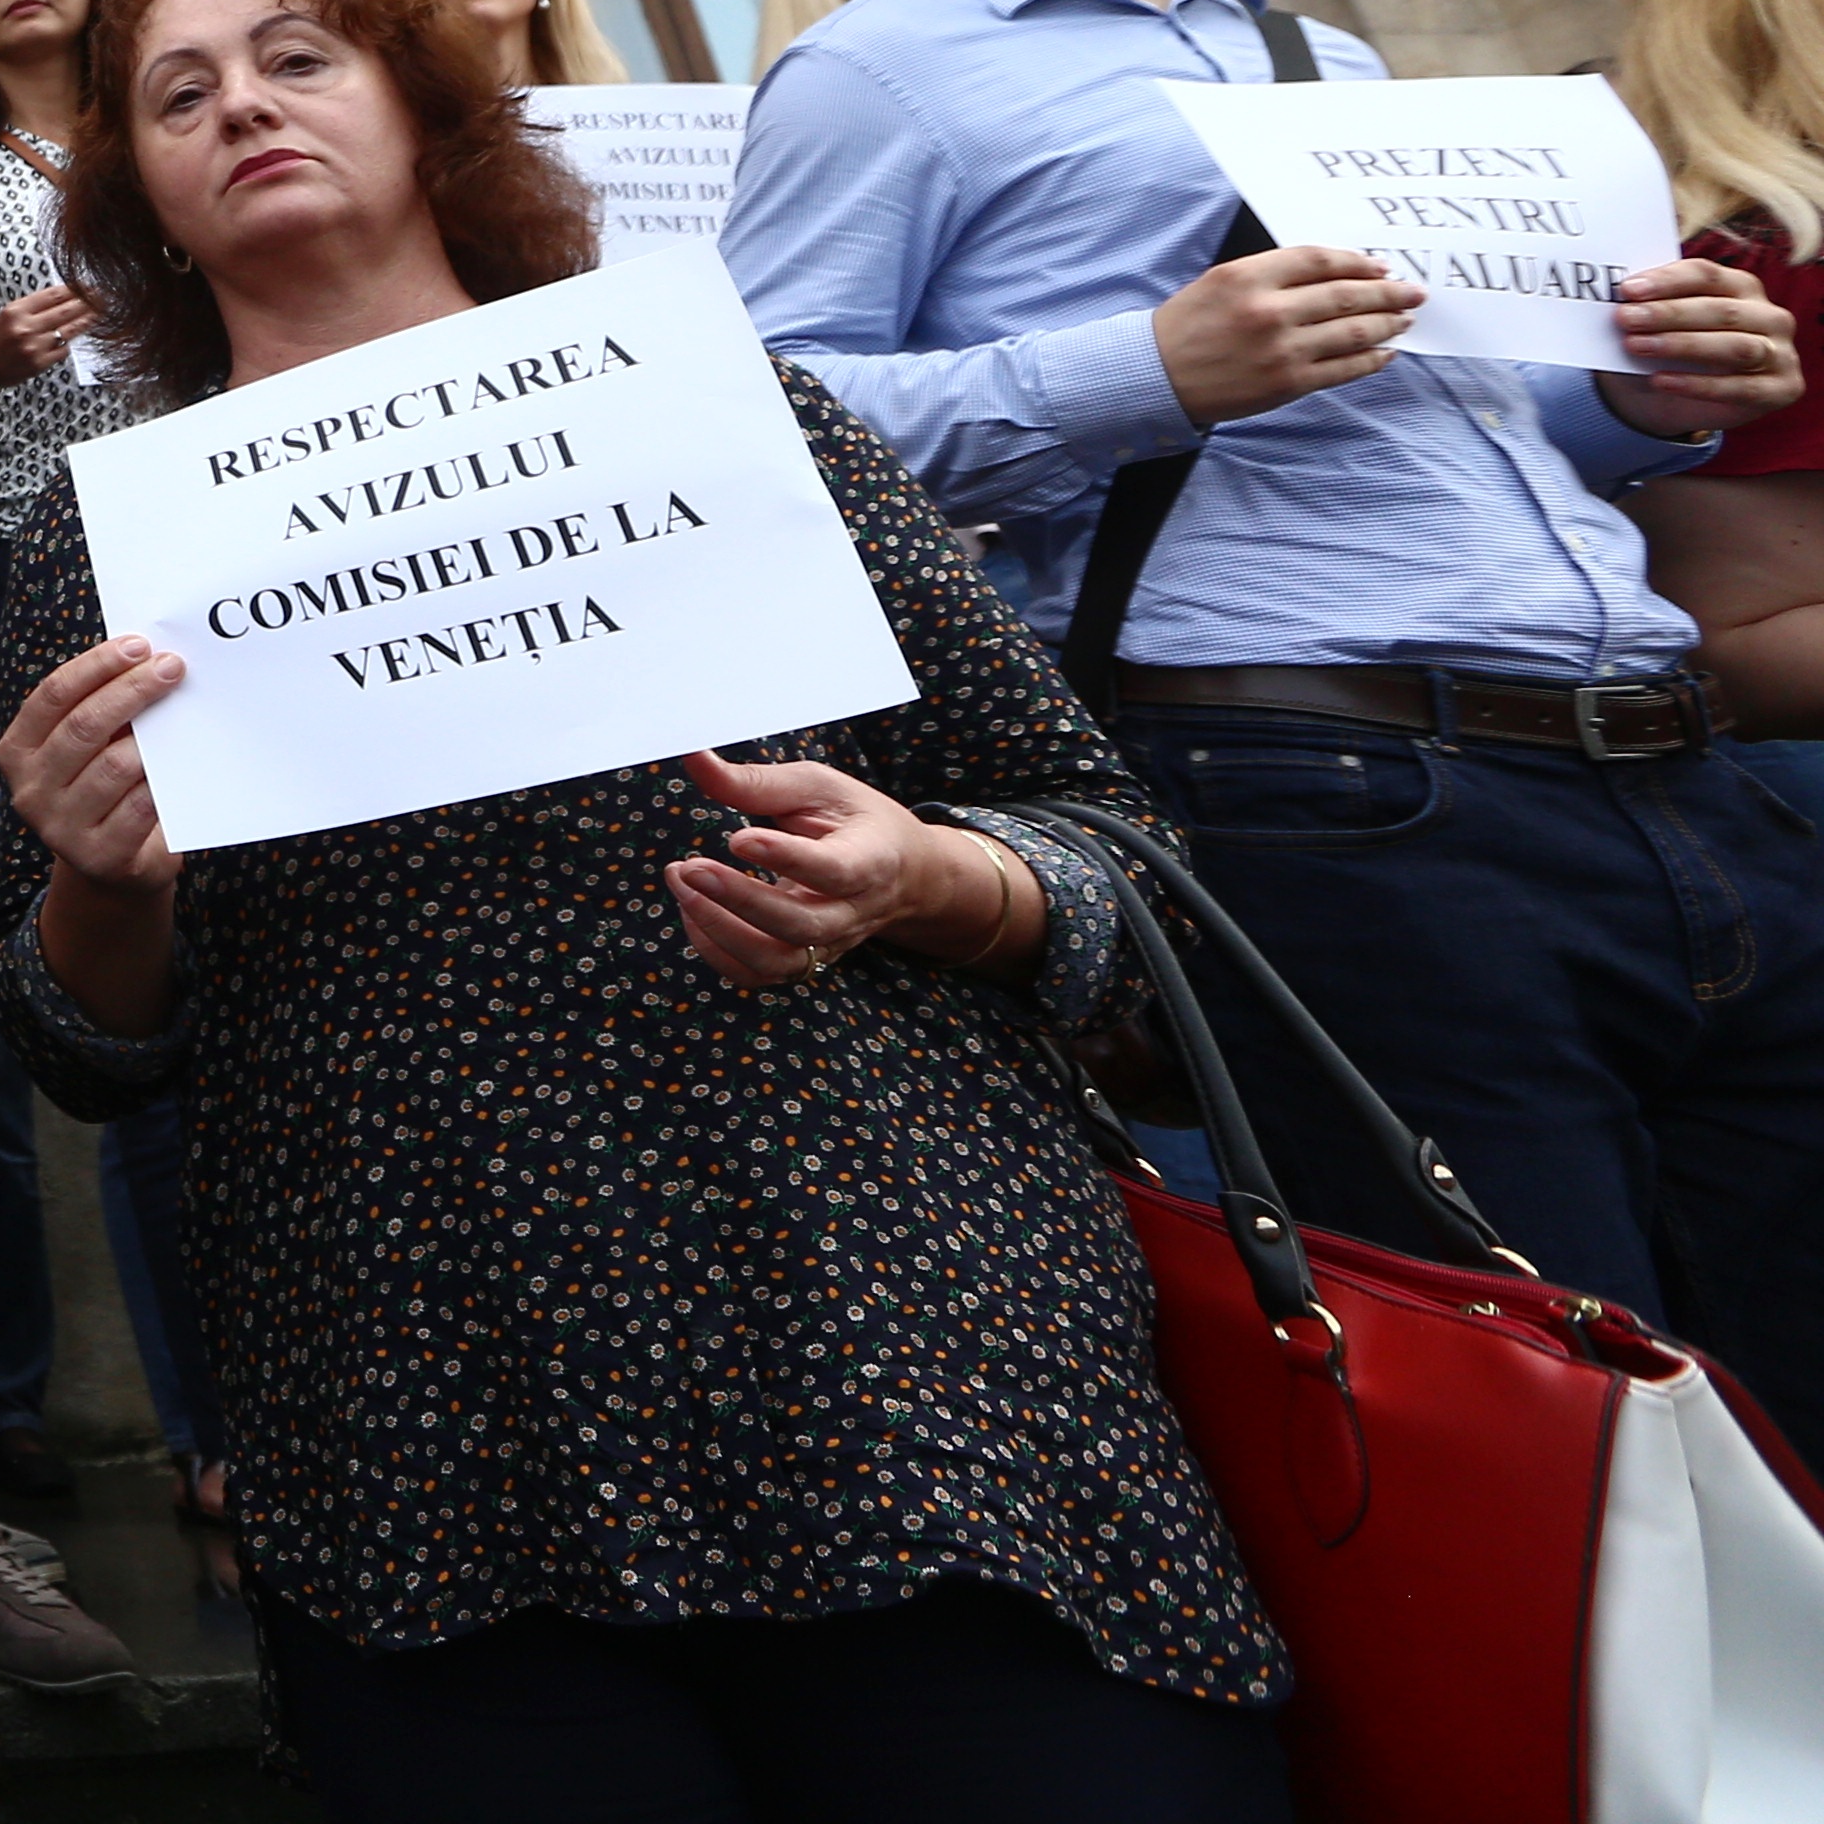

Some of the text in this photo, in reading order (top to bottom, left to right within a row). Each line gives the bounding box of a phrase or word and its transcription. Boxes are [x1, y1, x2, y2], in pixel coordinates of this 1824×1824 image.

[609, 147, 730, 166] AVIZULUI
[1307, 148, 1570, 179] PREZENT
[699, 184, 731, 201] DE
[1365, 196, 1585, 237] PENTRU
[207, 335, 639, 487] RESPECTAREA
[284, 430, 578, 540] AVIZULUI
[208, 491, 708, 640] COMISIEI DE LA
[330, 595, 623, 689] VENEȚIA
